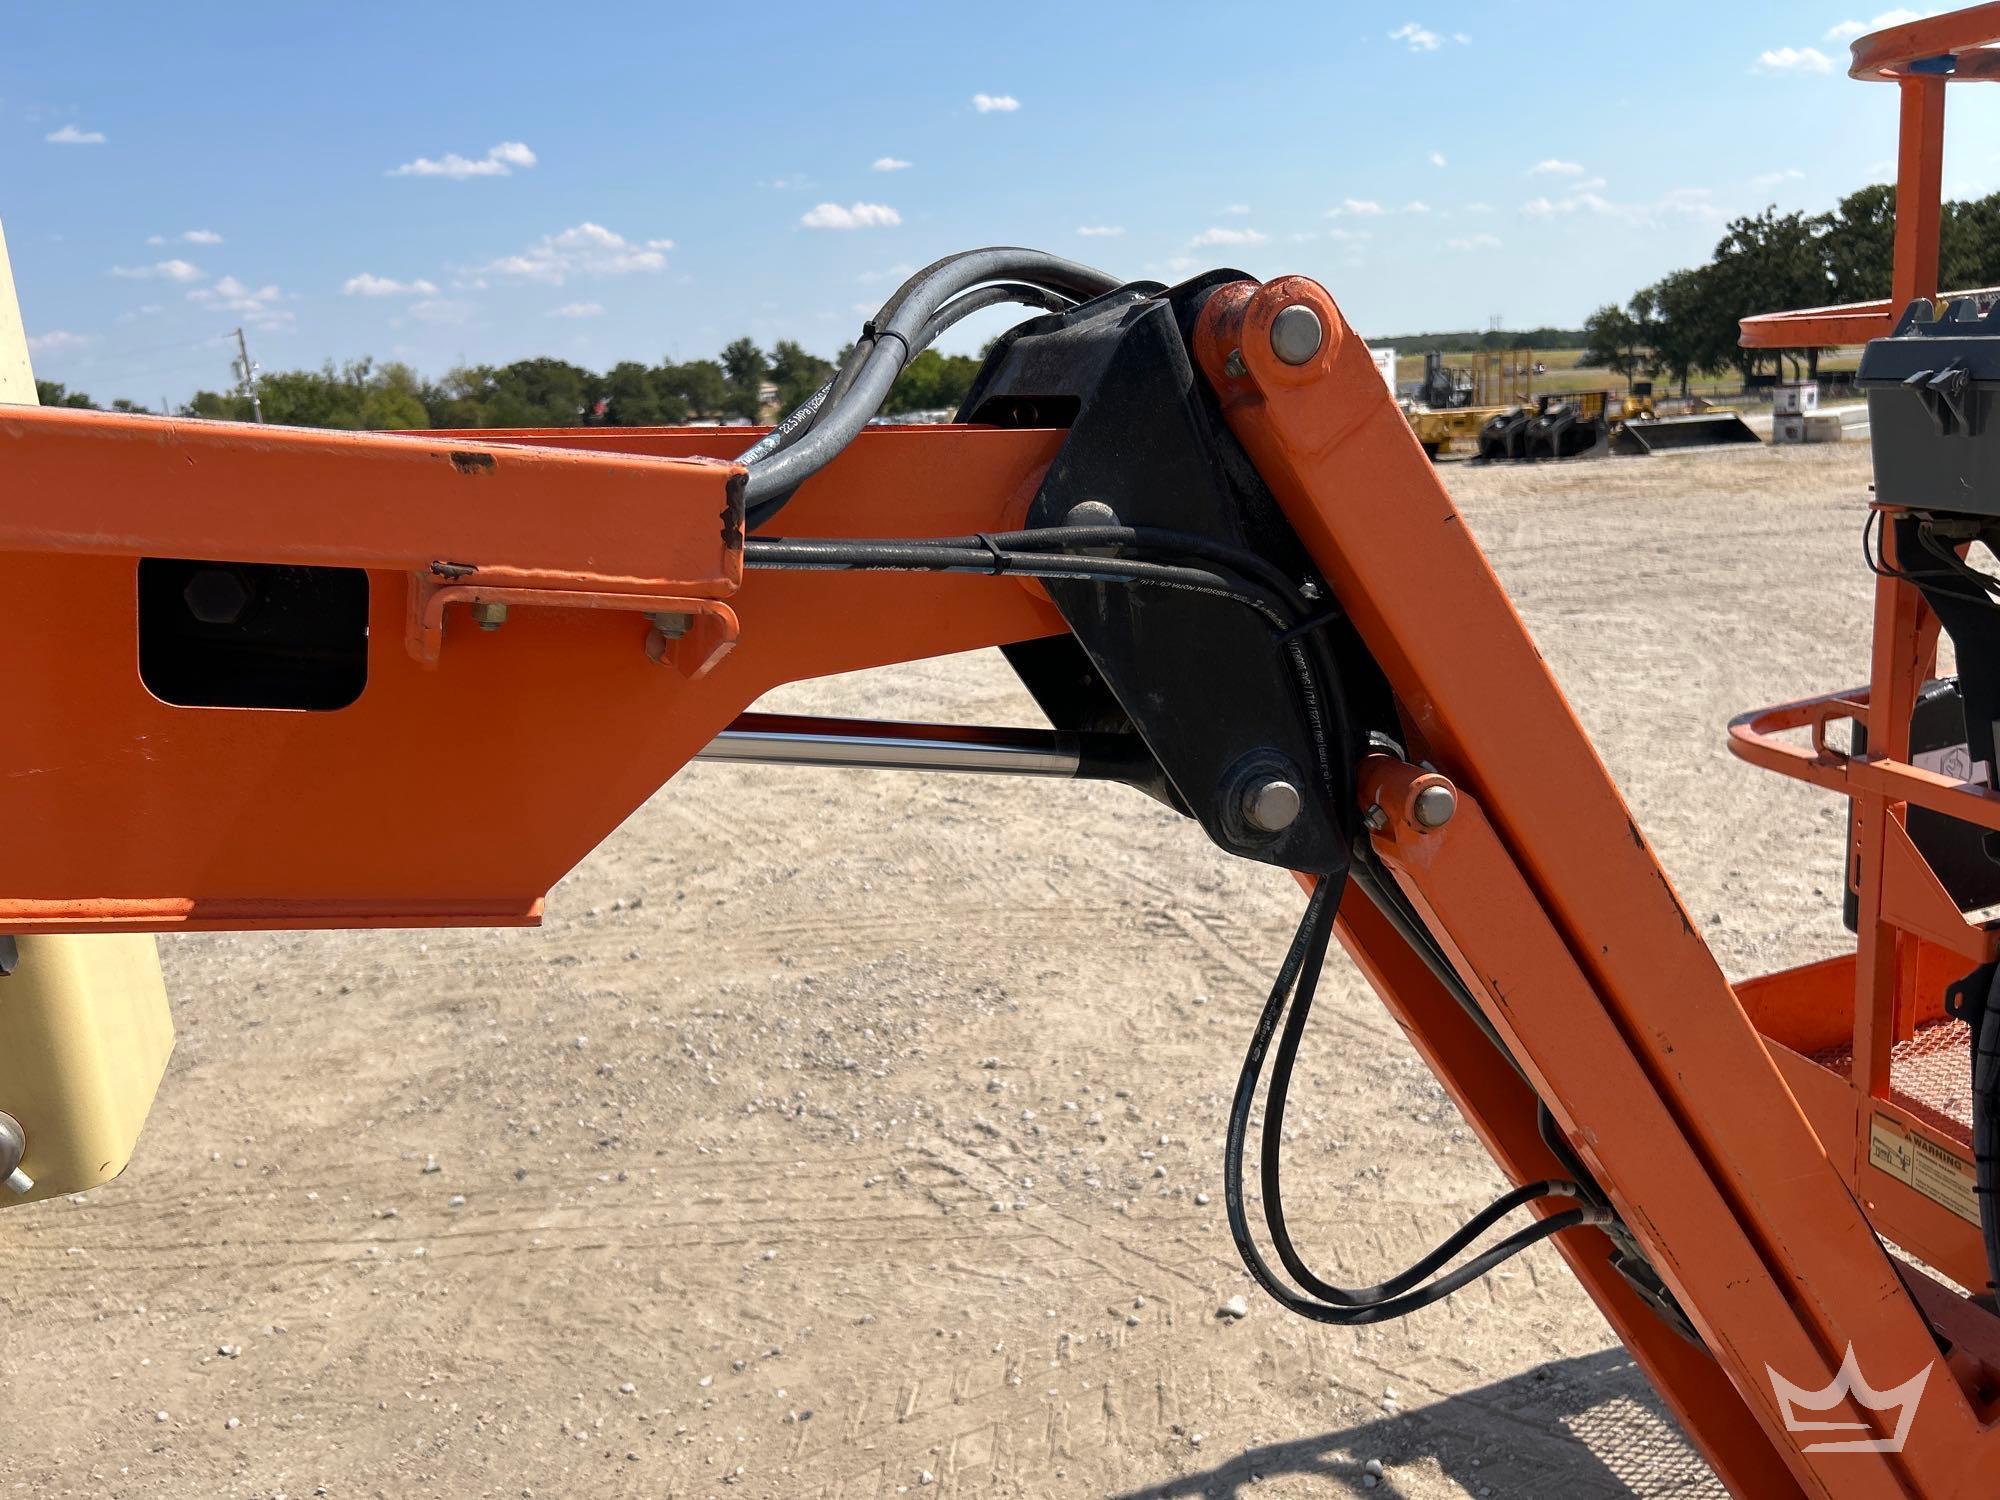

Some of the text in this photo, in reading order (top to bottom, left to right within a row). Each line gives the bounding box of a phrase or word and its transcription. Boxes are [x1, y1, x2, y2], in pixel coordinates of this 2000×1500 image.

[779, 418, 798, 435] 22.5
[796, 408, 811, 423] MPa
[1914, 1137, 1962, 1171] WARNING
